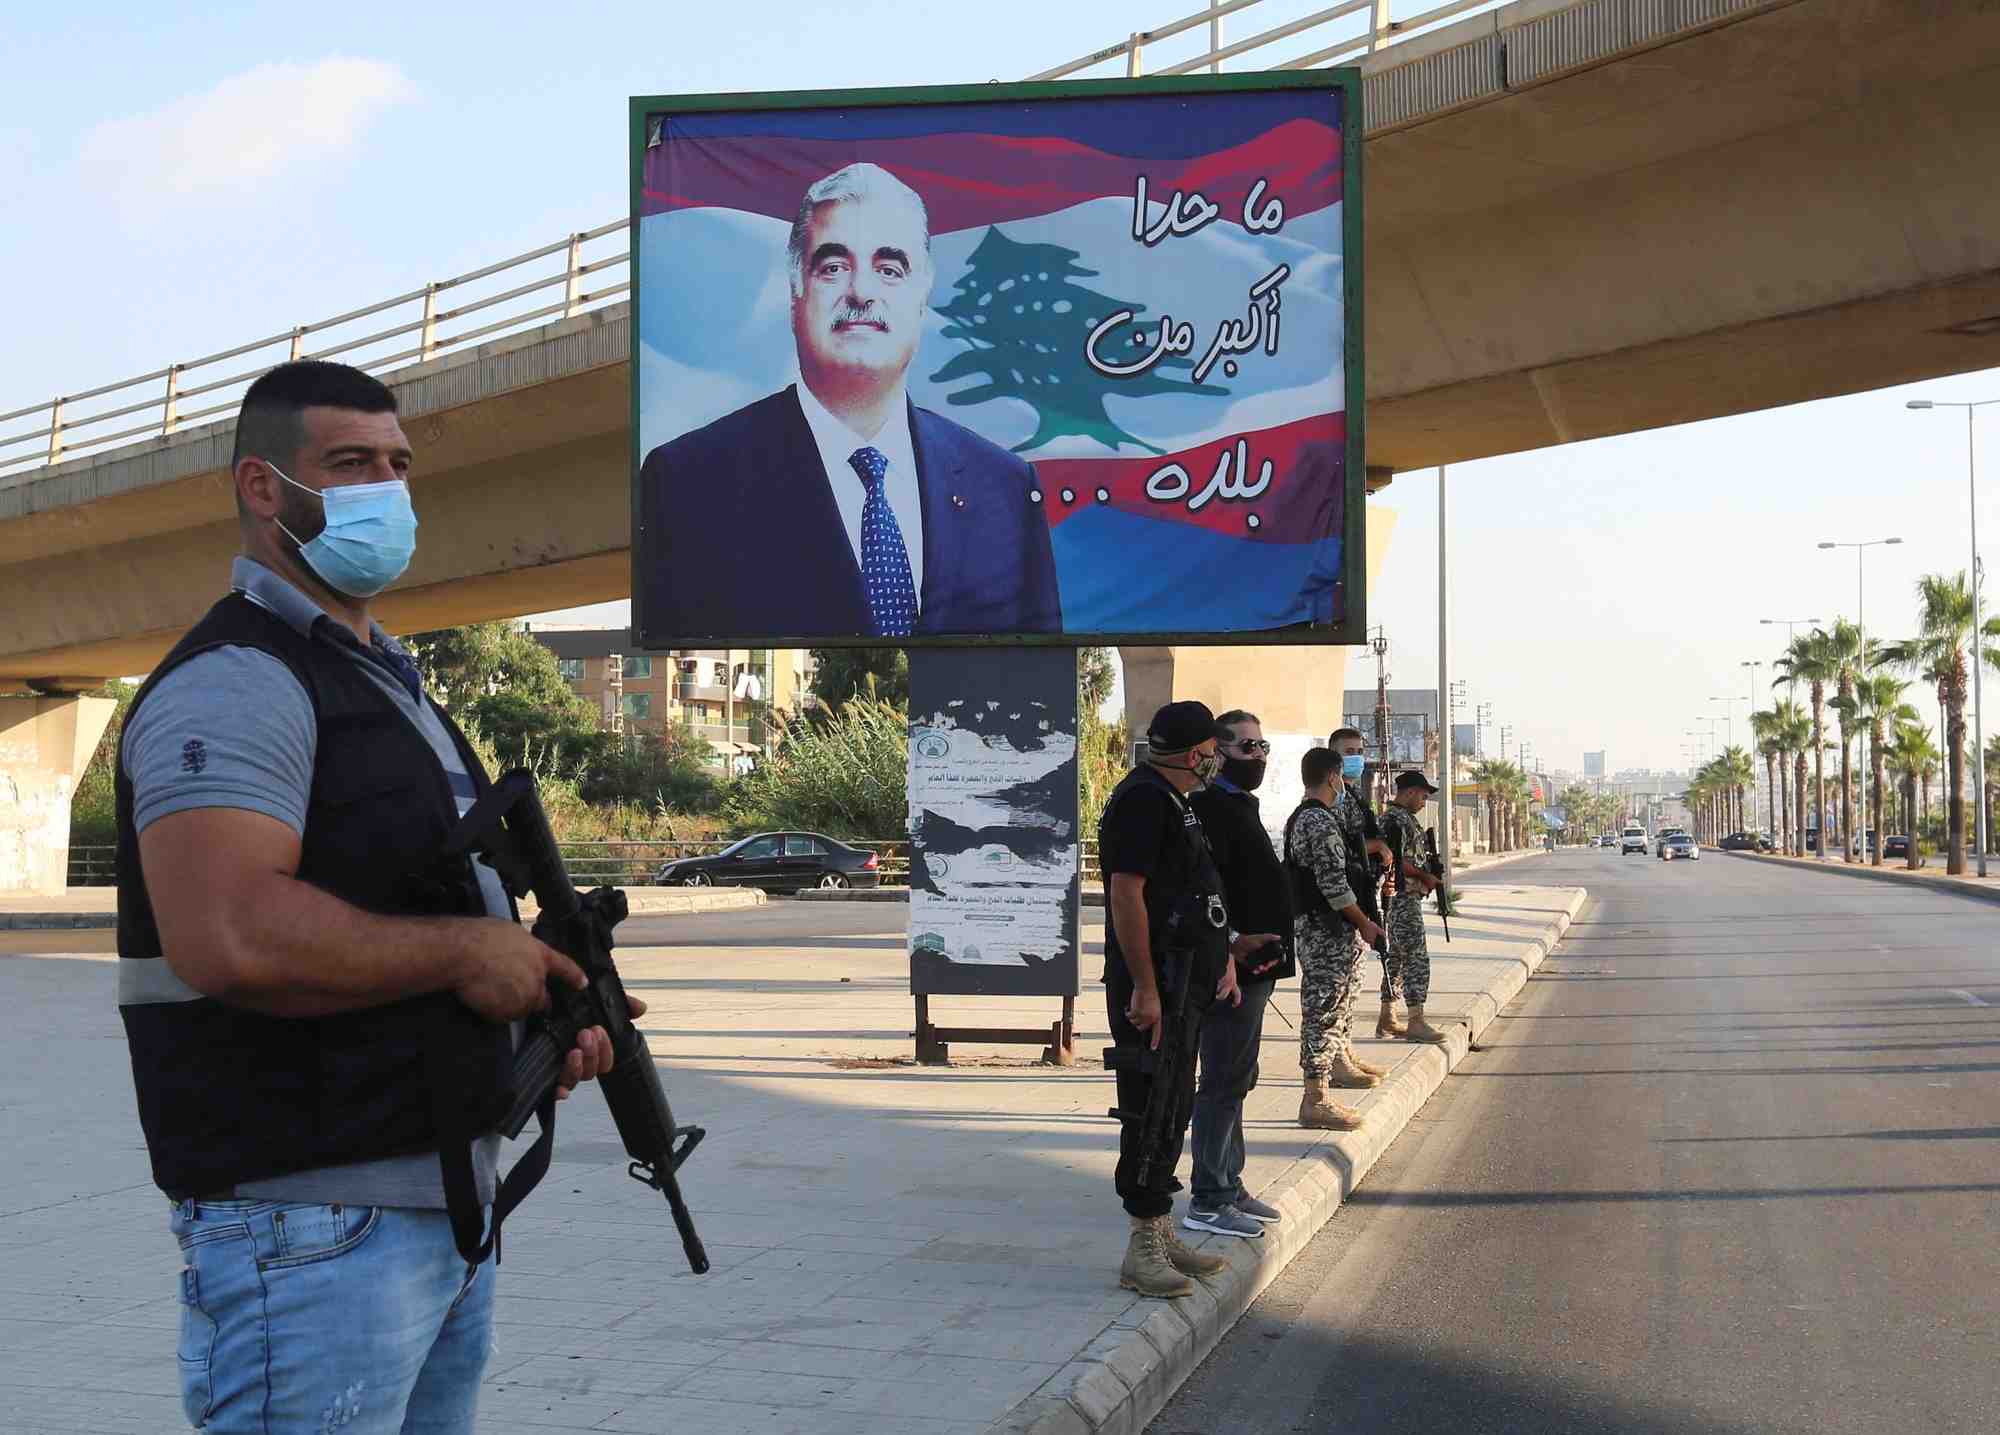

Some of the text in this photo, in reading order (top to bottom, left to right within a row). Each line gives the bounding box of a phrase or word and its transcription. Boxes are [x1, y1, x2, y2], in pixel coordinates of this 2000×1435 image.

[1131, 175, 1284, 247] ما حدا
[1084, 263, 1290, 384] أكبر من
[1144, 438, 1273, 531] بلده
